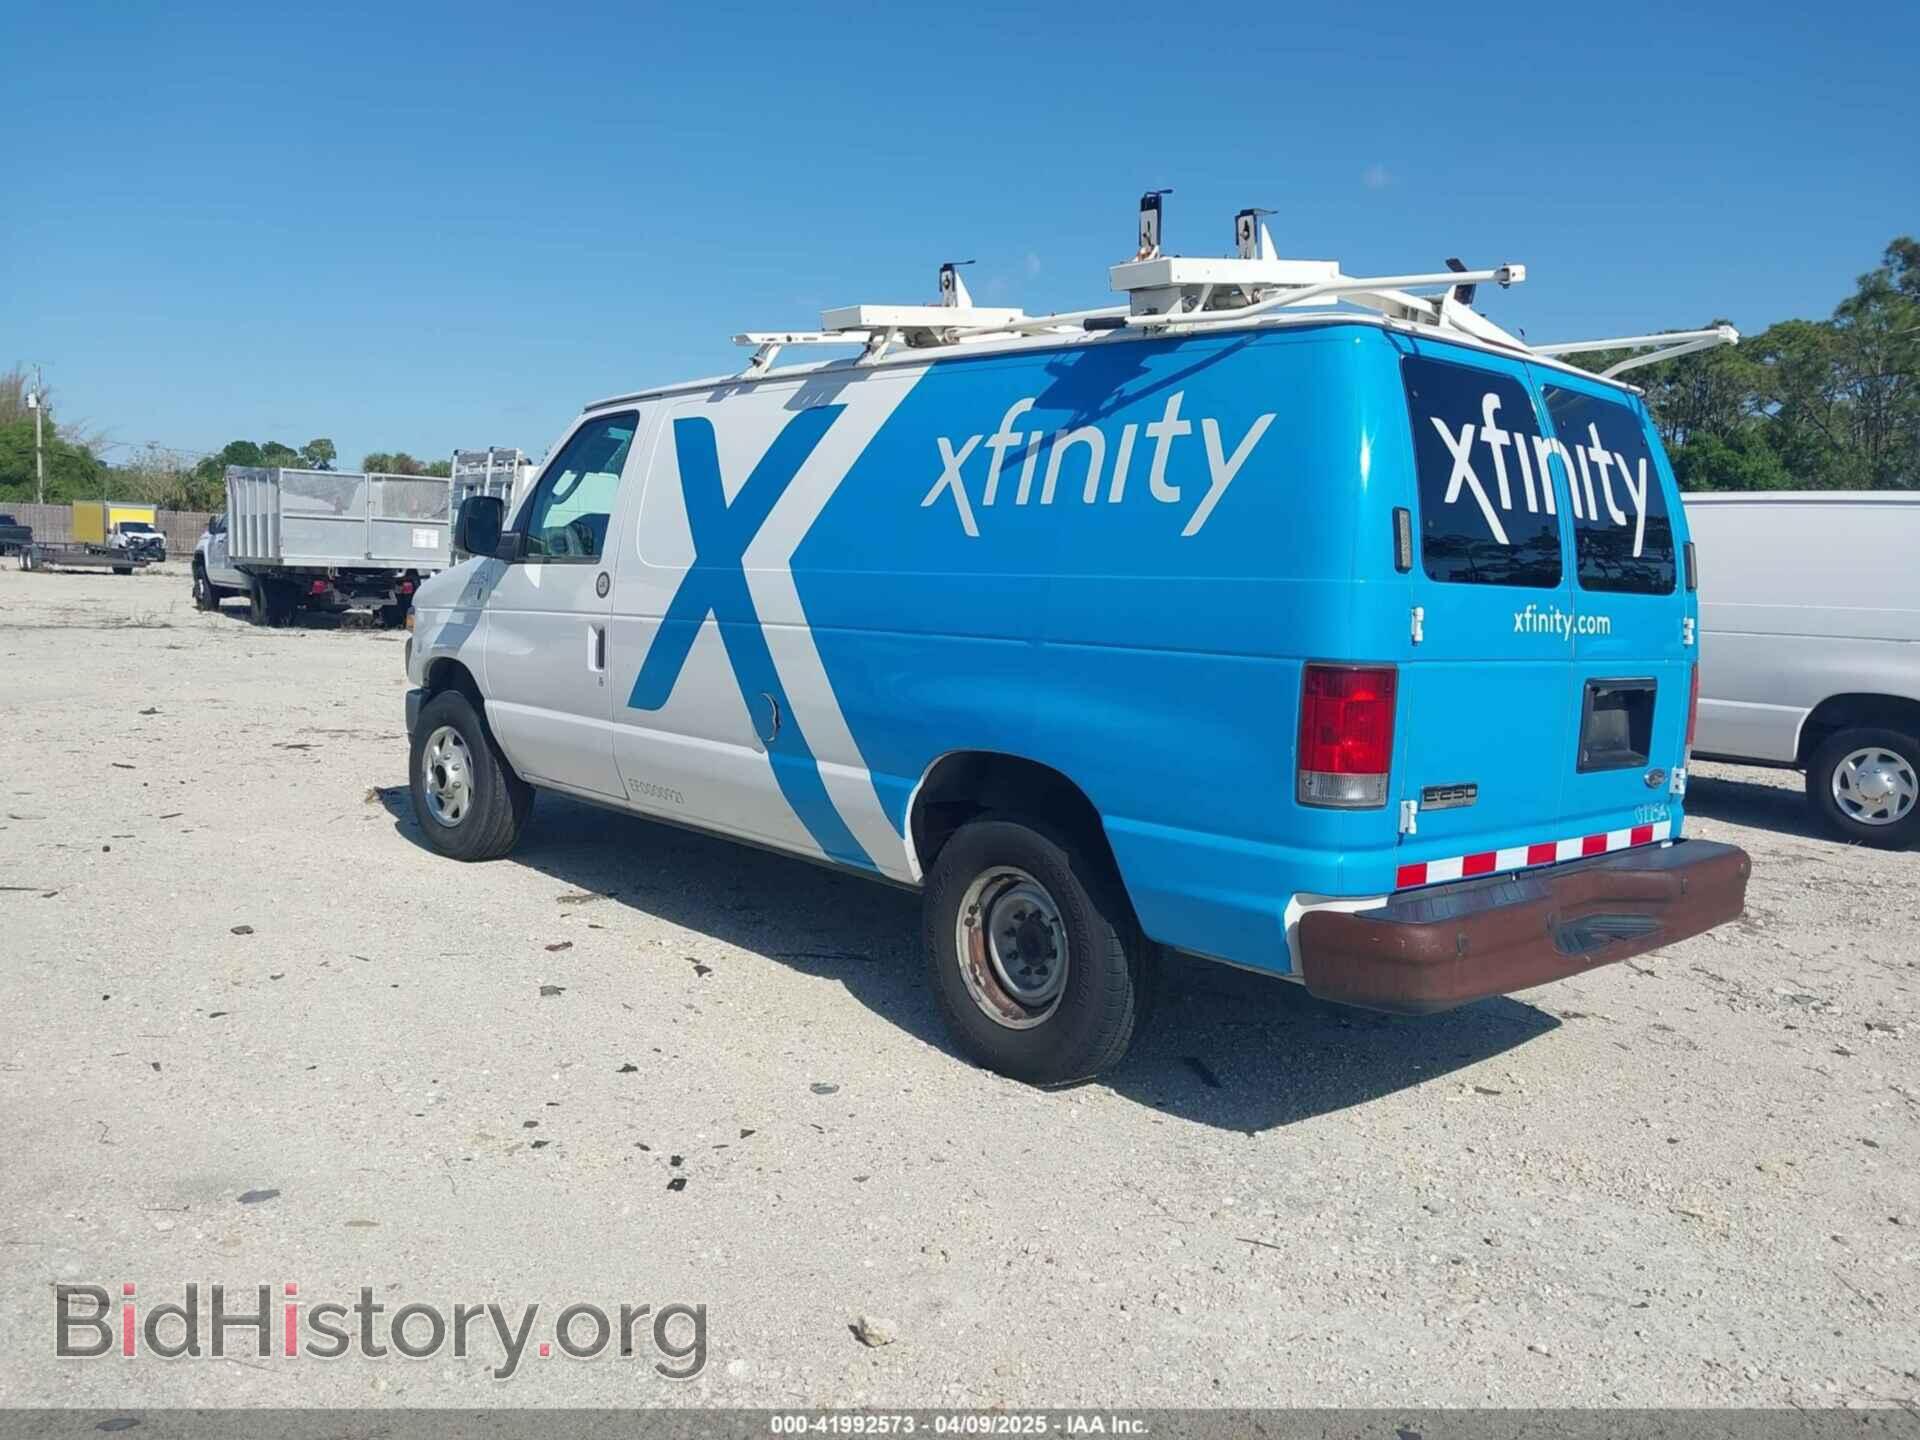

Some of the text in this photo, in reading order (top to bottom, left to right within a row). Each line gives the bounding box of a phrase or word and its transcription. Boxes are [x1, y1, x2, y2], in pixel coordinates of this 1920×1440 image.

[919, 390, 1277, 537] xfinity
[1430, 393, 1647, 558] xfinity
[1514, 603, 1611, 641] xfinity.com
